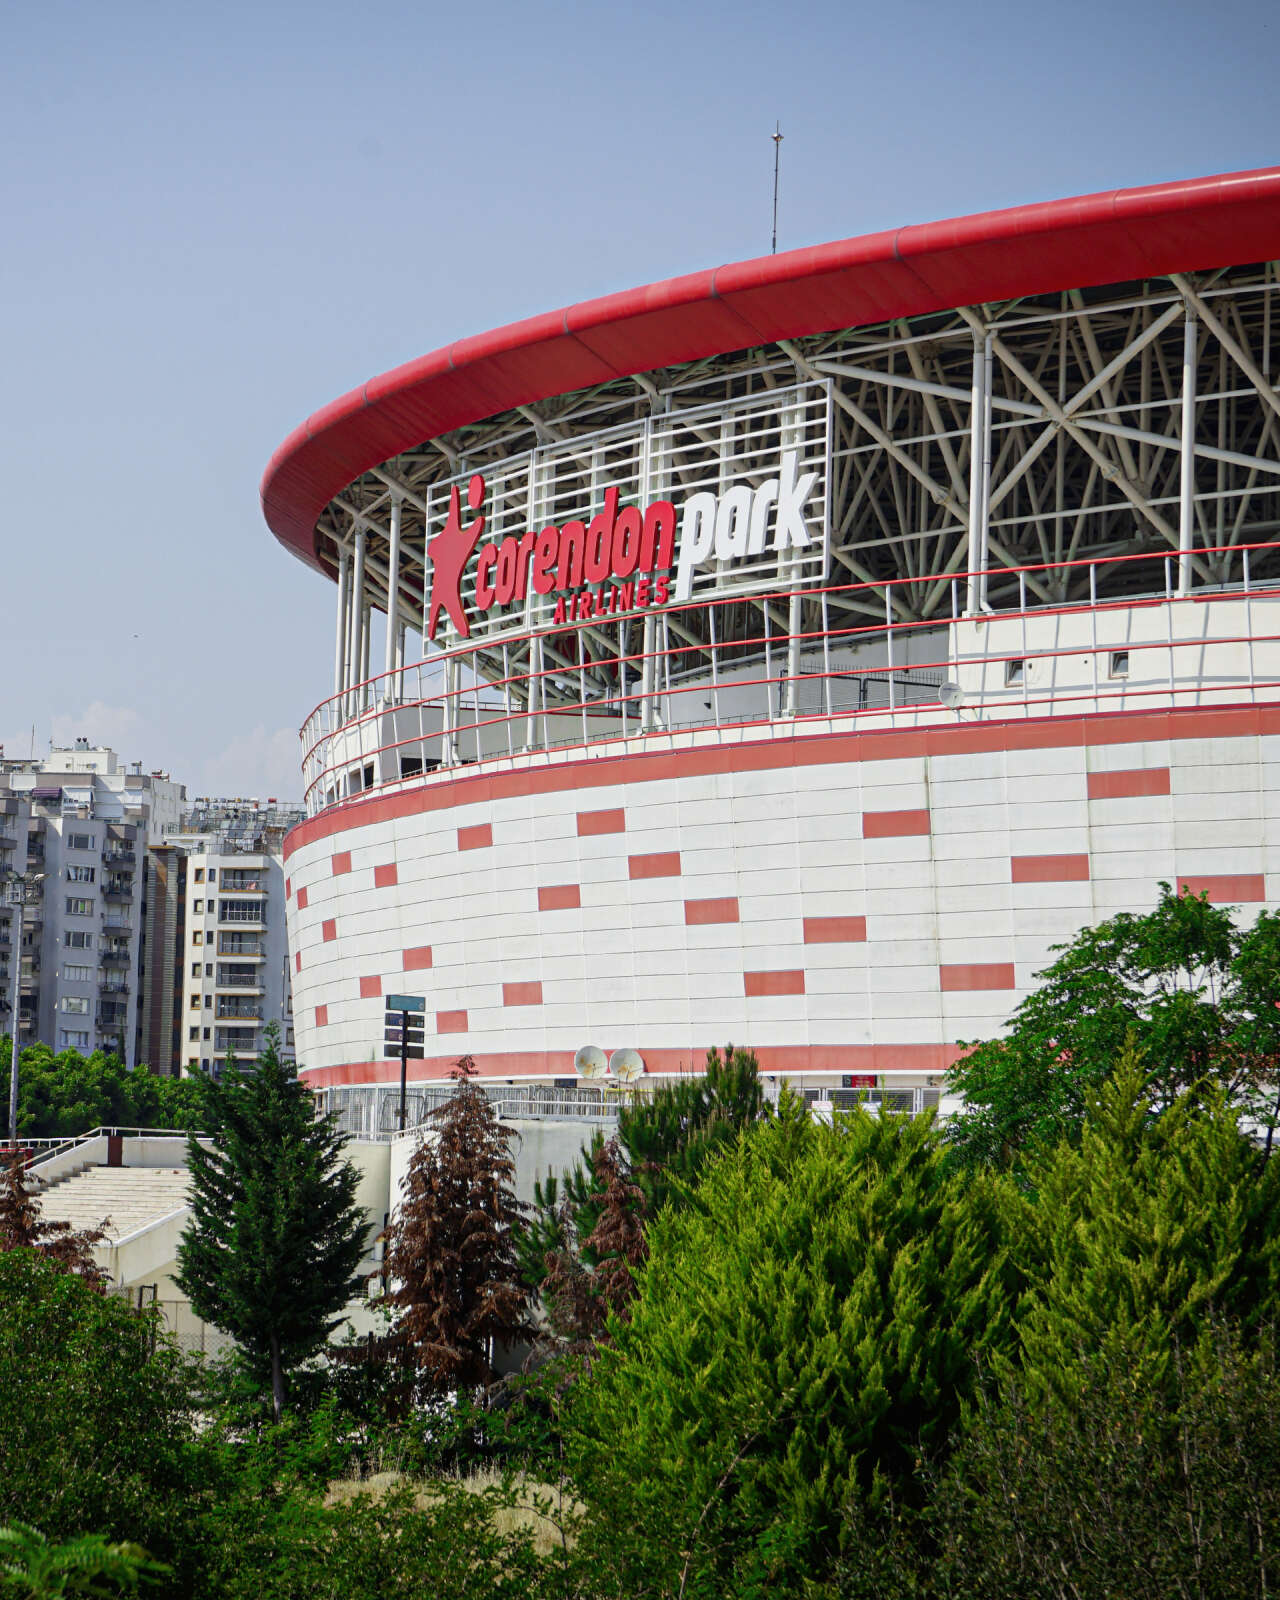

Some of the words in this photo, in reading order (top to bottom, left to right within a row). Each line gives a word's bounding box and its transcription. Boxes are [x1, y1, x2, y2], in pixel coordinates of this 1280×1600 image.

[475, 486, 676, 610] corendon
[675, 451, 820, 600] park
[553, 576, 670, 624] AIRLINES
